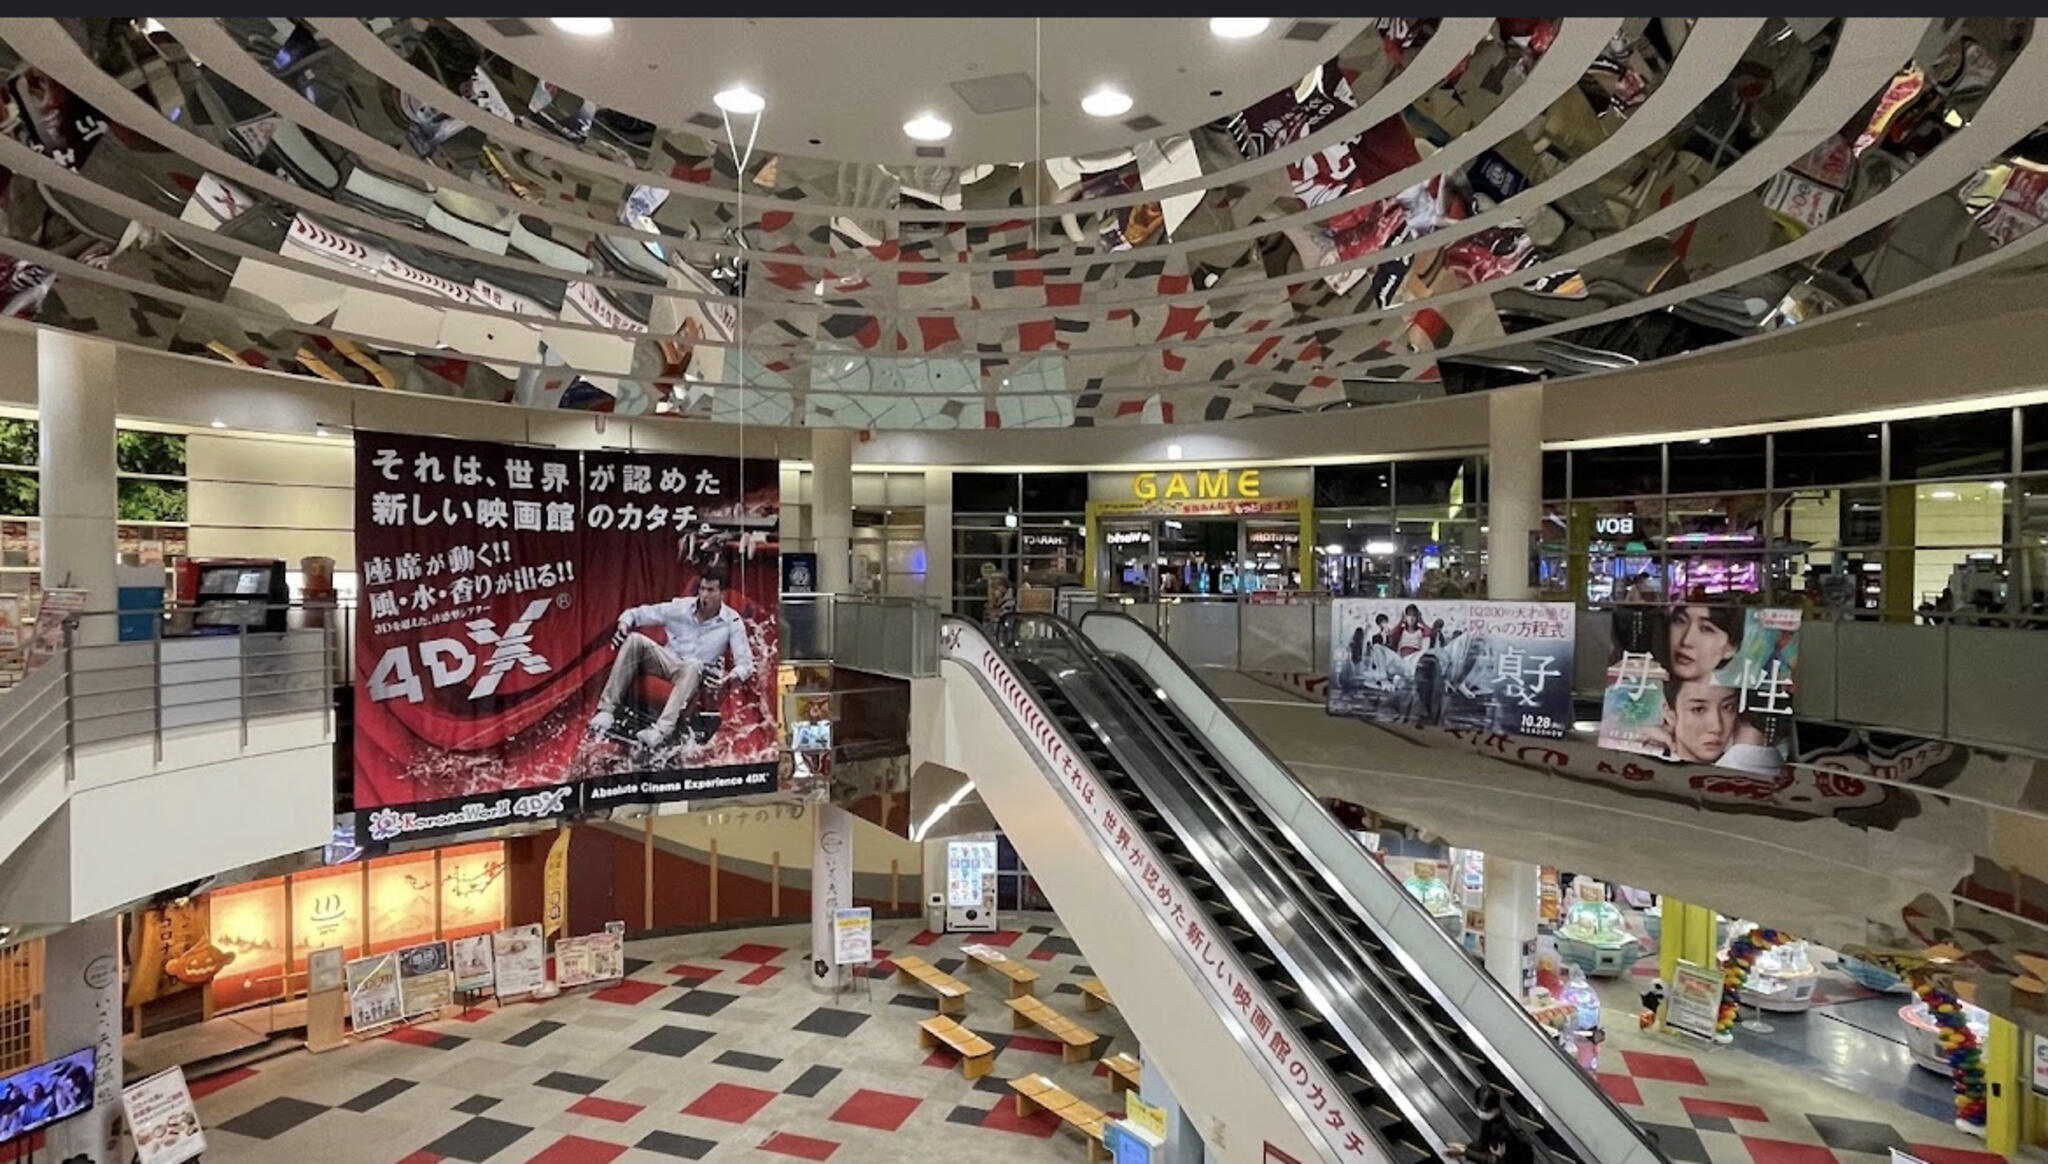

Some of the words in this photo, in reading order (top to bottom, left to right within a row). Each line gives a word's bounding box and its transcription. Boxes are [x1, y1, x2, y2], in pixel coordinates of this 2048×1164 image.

[372, 449, 720, 494] それは、世界が認めた
[1133, 469, 1260, 499] GAME
[372, 491, 710, 533] 新しい映画館のカタチ。
[1491, 646, 1561, 694] 貞子
[1520, 713, 1551, 729] 10.28
[591, 784, 638, 799] Absolute
[640, 781, 682, 793] Cinema
[684, 774, 743, 790] Experience
